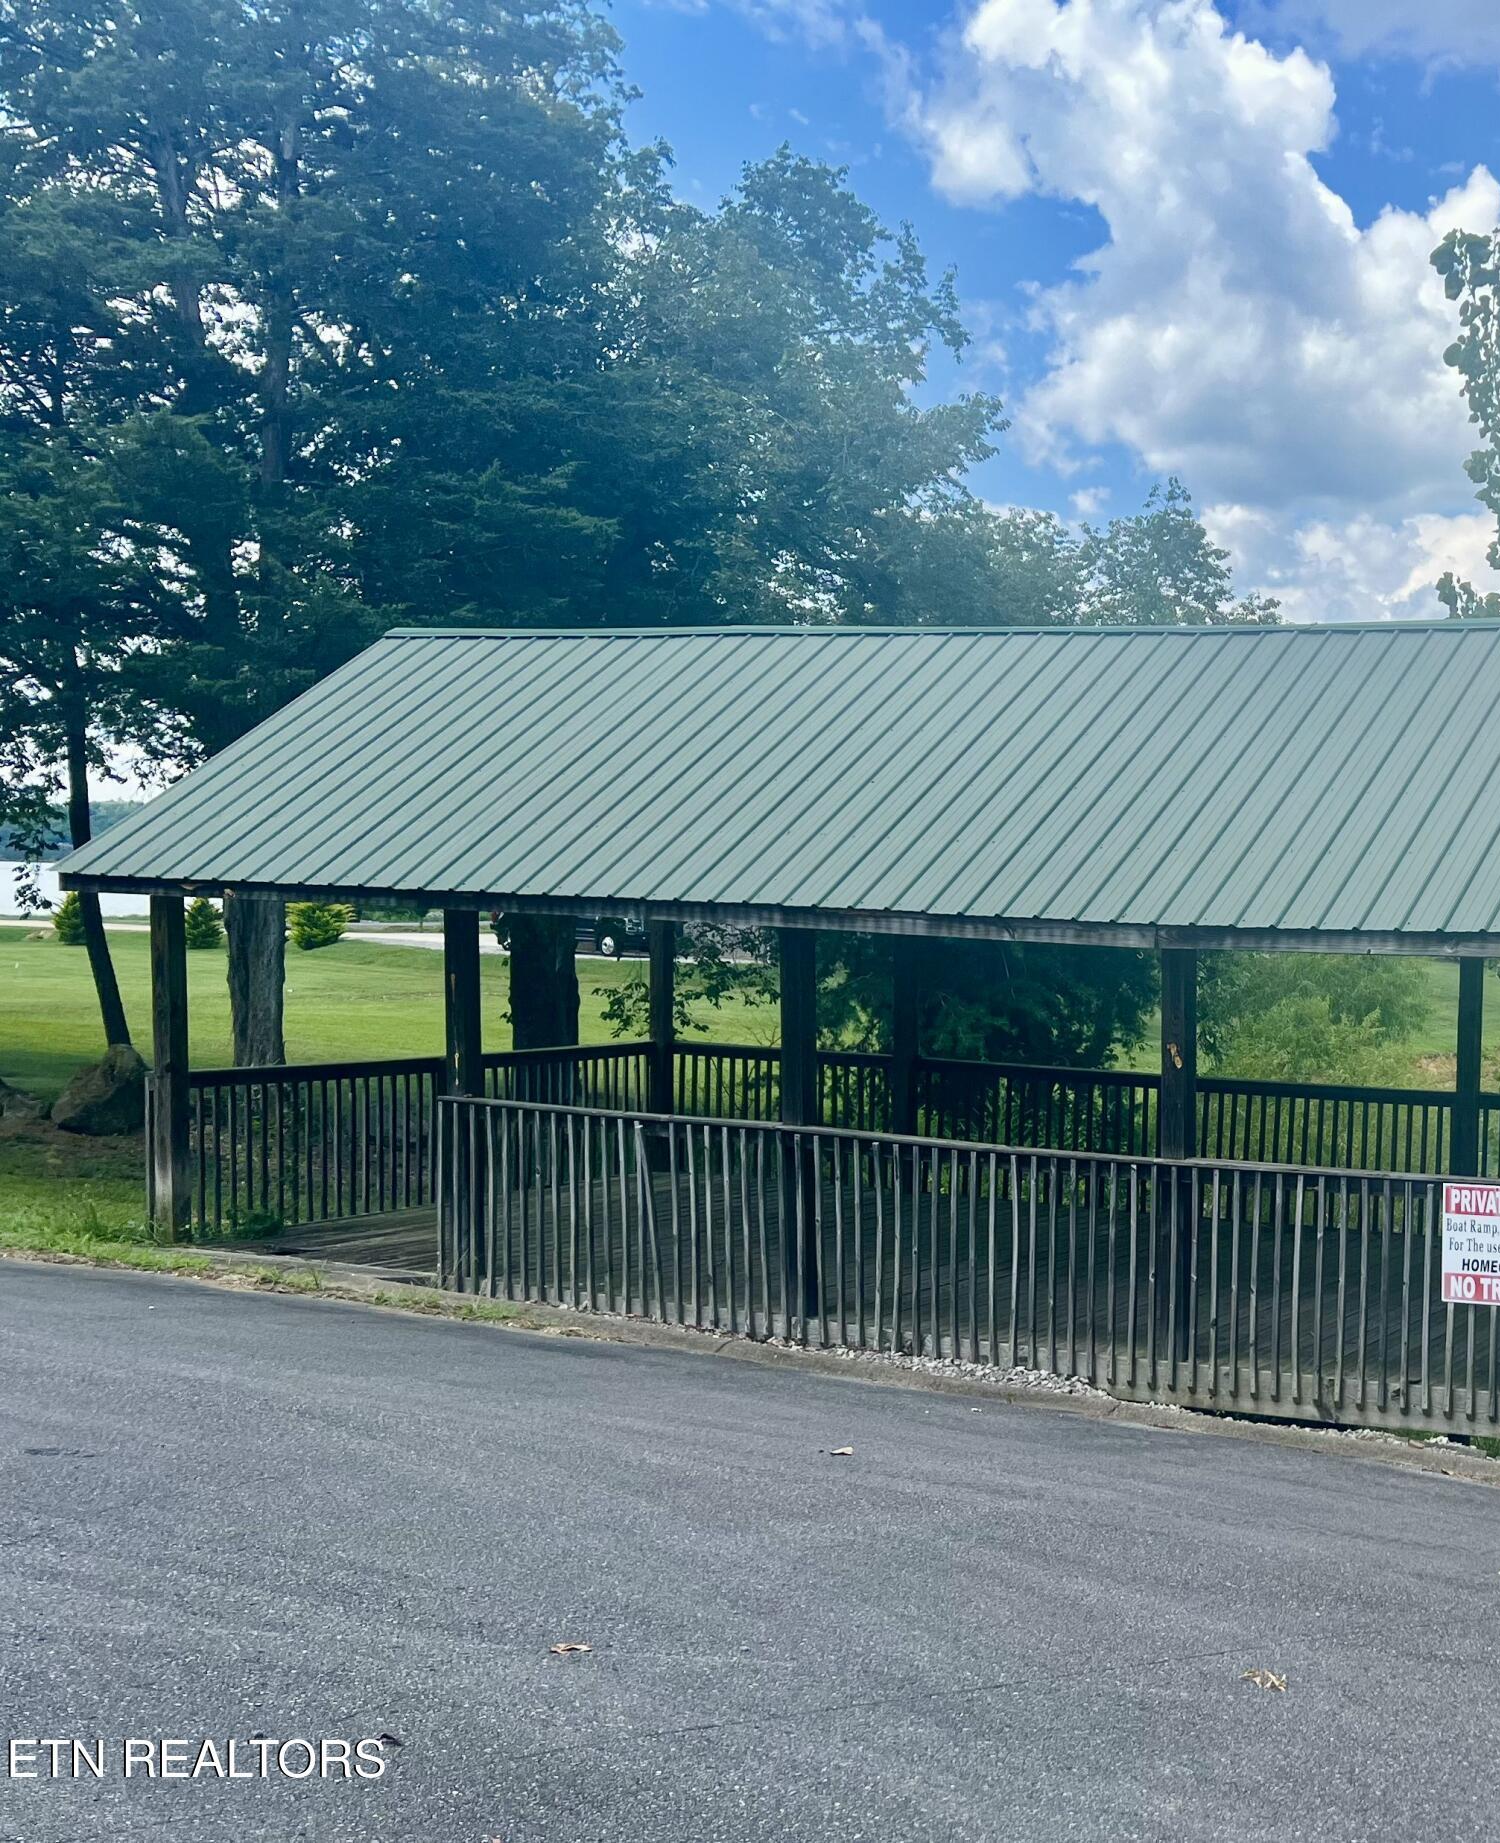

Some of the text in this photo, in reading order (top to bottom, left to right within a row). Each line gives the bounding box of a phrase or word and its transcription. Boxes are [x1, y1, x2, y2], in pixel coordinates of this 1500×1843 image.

[1446, 1218, 1467, 1232] Boat
[1449, 1237, 1464, 1251] For
[1466, 1239, 1484, 1252] The
[1450, 1275, 1476, 1299] NO
